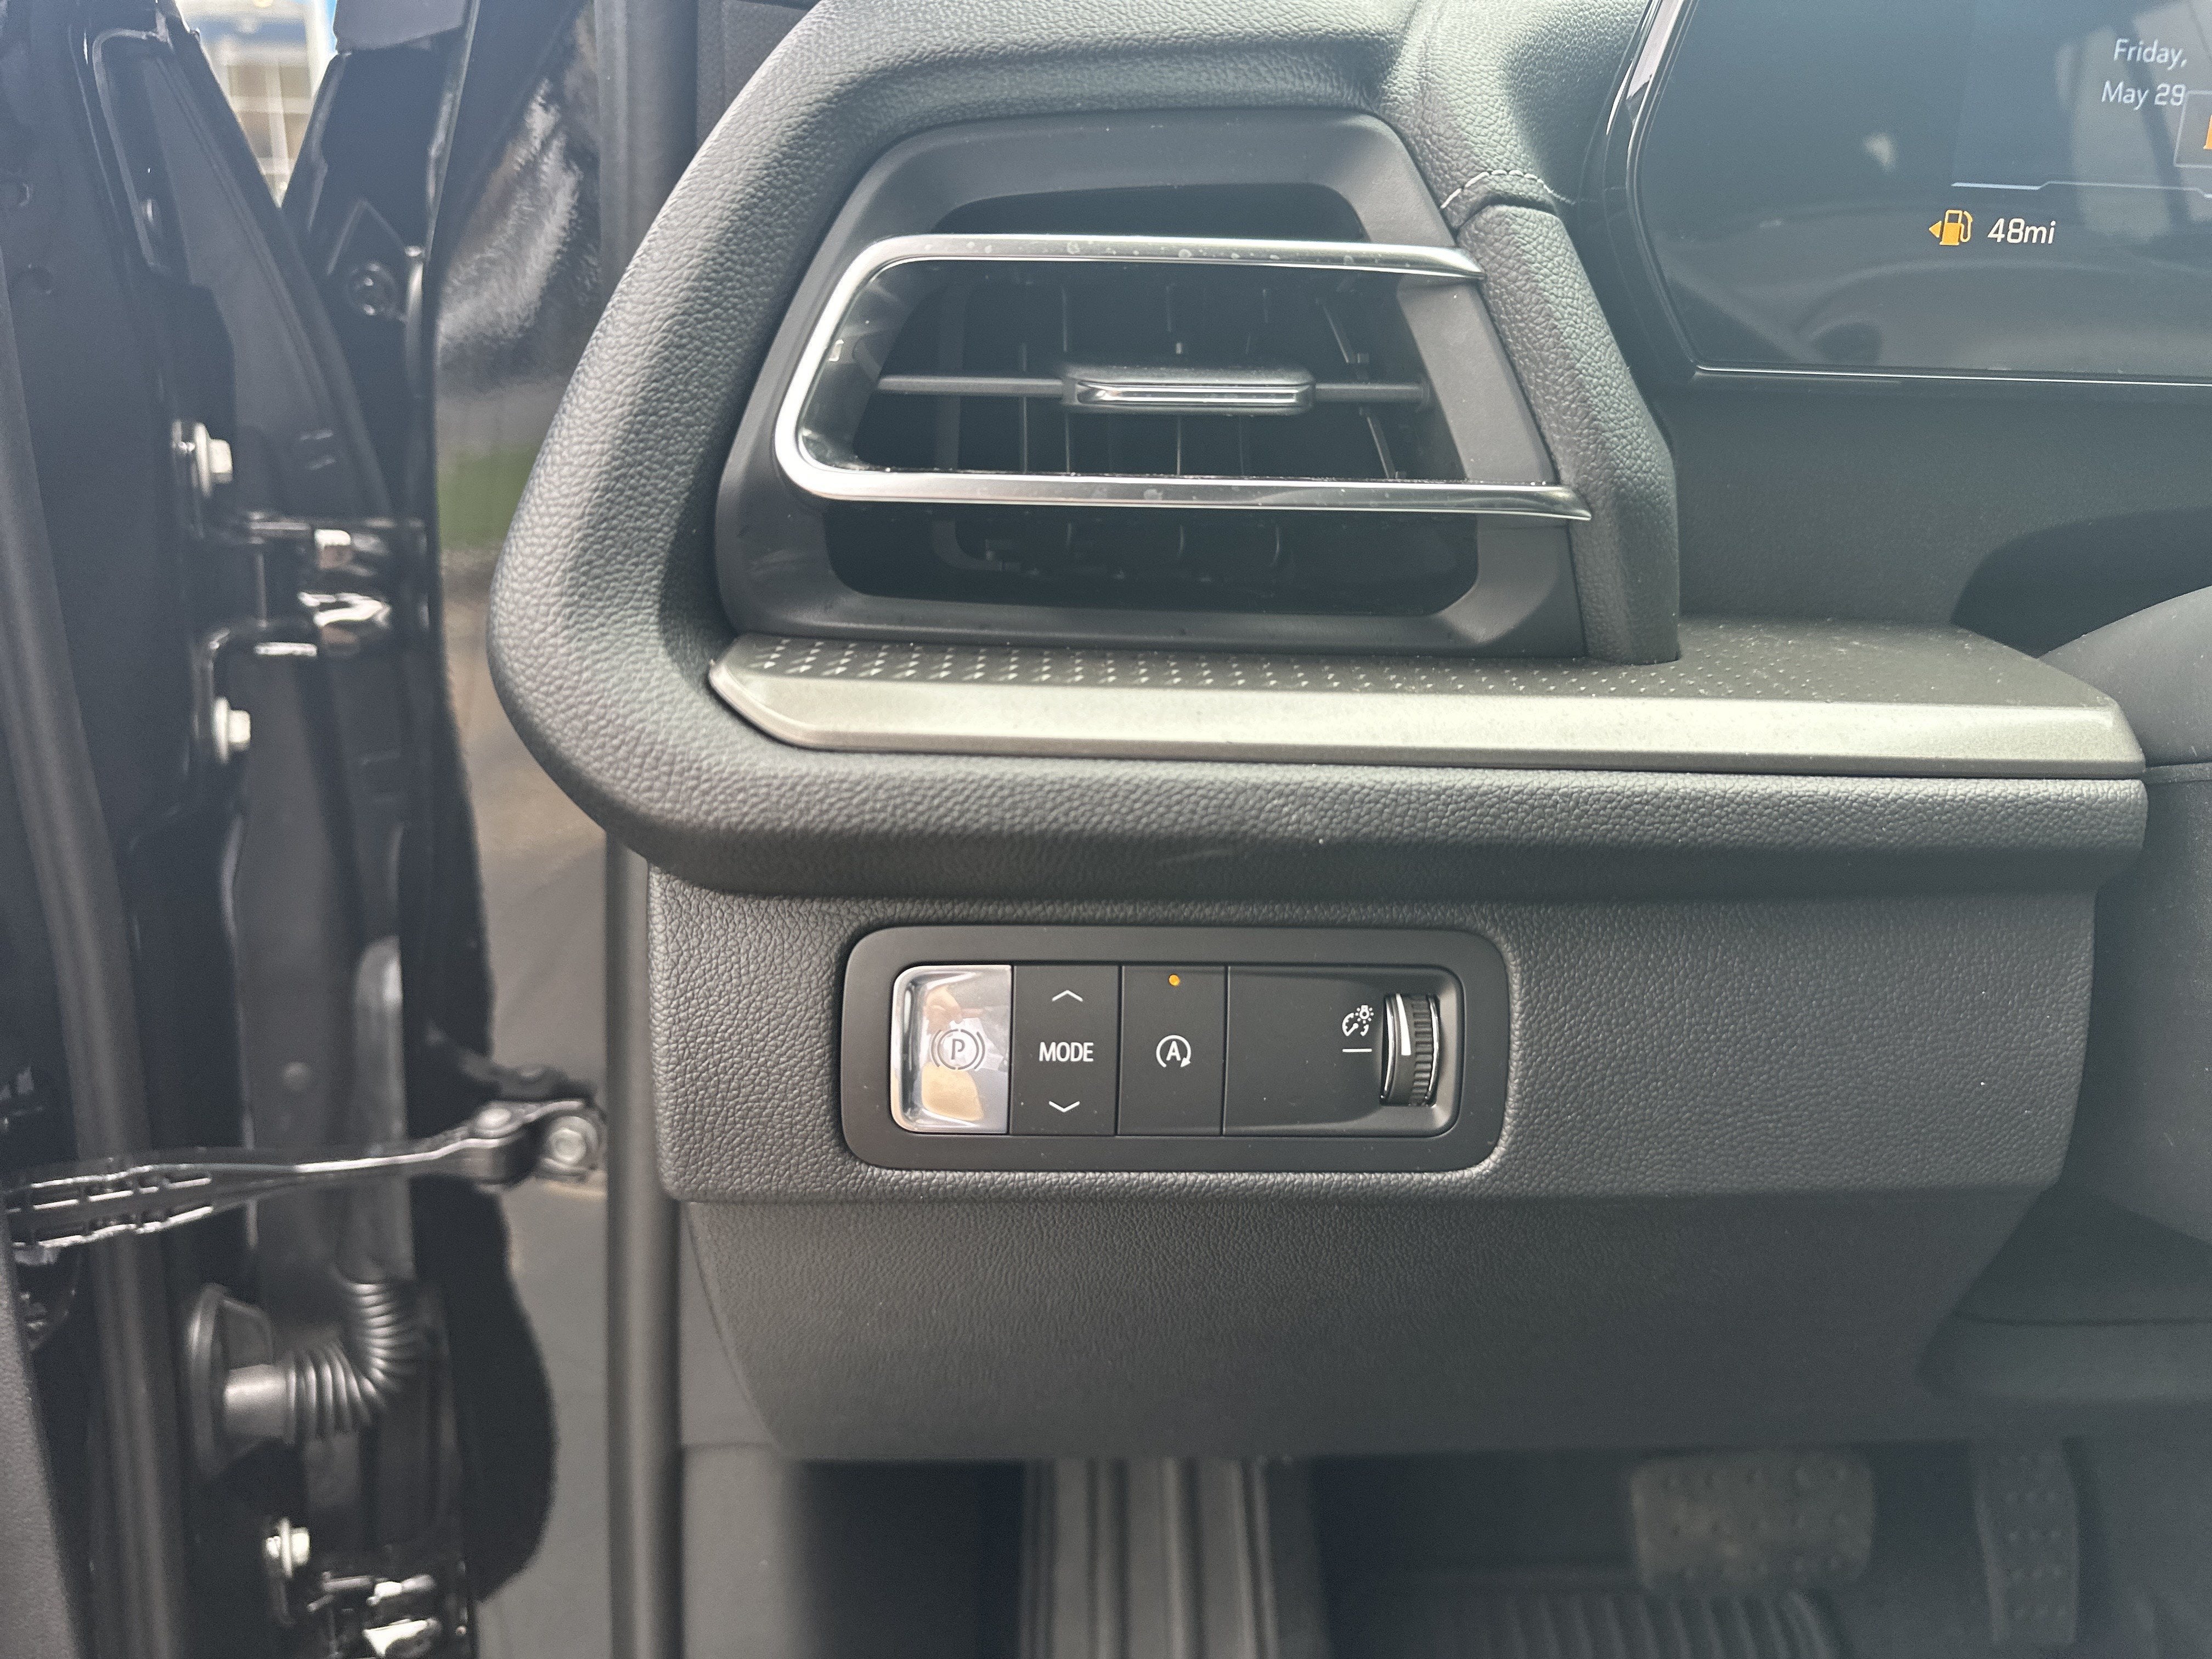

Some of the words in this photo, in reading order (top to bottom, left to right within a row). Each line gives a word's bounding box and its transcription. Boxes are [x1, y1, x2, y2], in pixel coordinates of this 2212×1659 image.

[2113, 38, 2188, 70] Friday,
[2101, 80, 2148, 111] May
[2154, 83, 2187, 107] 29
[1987, 218, 2056, 245] 48mi
[951, 1038, 966, 1060] P
[1039, 1041, 1094, 1063] MODE
[1167, 1041, 1180, 1060] A
